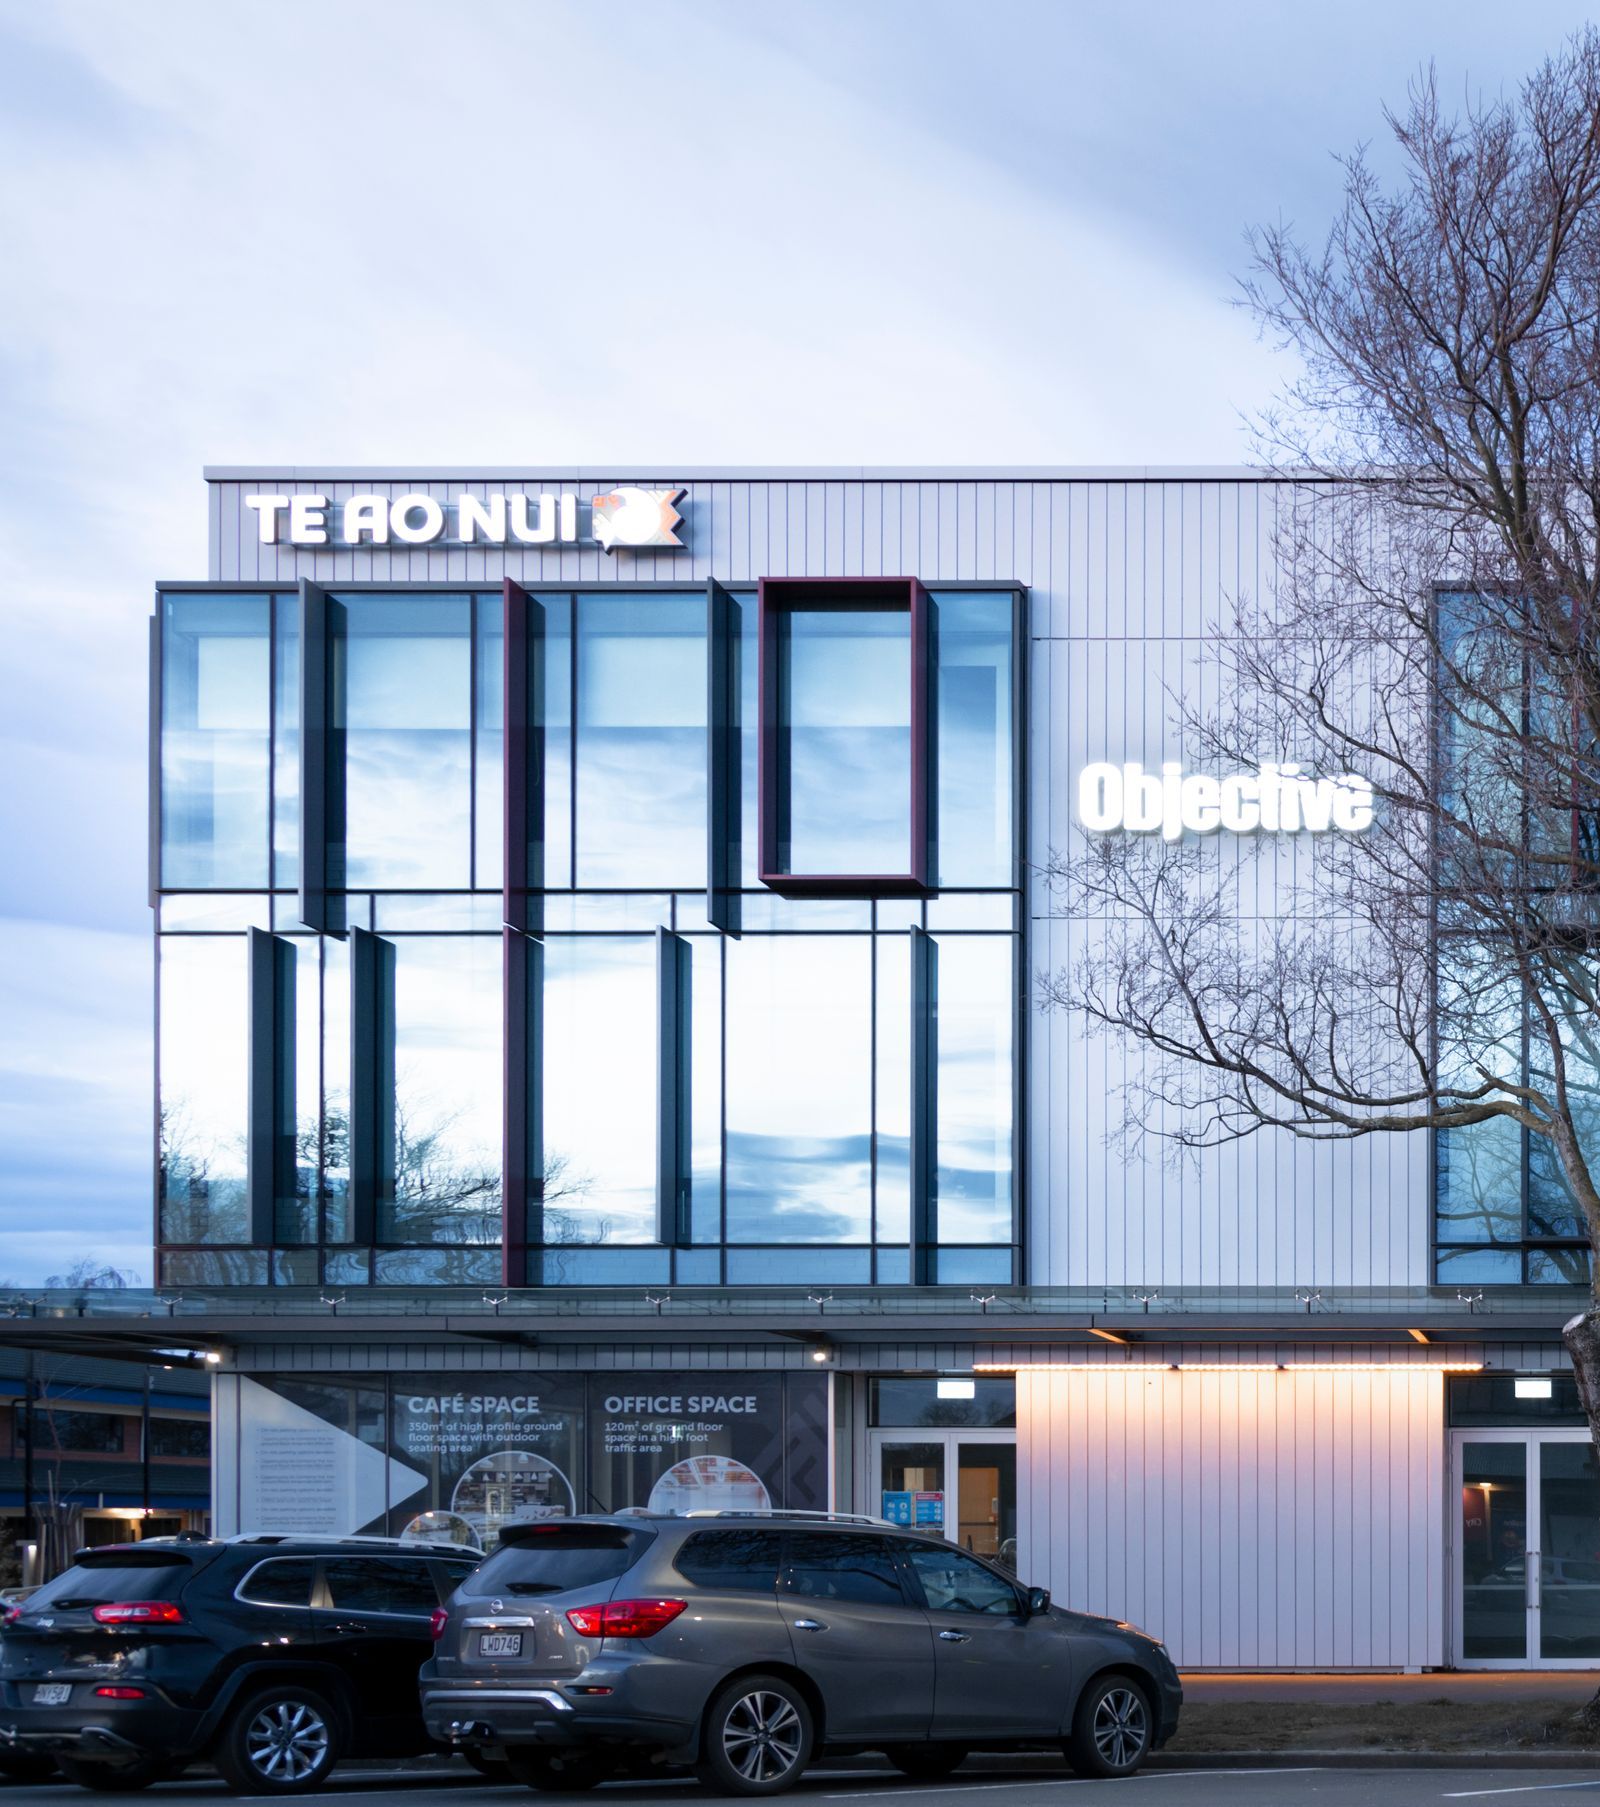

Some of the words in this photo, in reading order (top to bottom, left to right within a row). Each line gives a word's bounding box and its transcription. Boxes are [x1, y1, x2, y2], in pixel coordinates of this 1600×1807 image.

[245, 494, 330, 545] TE
[343, 494, 449, 545] AO
[457, 493, 579, 544] NUI
[1079, 763, 1373, 841] Objective
[408, 1392, 464, 1413] CAFÉ
[470, 1396, 540, 1413] SPACE
[604, 1396, 683, 1413] OFFICE
[687, 1396, 758, 1413] SPACE
[446, 1422, 457, 1431] of
[459, 1422, 483, 1434] high
[486, 1421, 520, 1434] profile
[523, 1422, 563, 1434] ground
[642, 1422, 653, 1431] of
[697, 1421, 723, 1431] floor
[408, 1432, 433, 1441] floor
[437, 1434, 467, 1445] space
[470, 1432, 493, 1441] with
[496, 1432, 540, 1441] outdoor
[604, 1434, 636, 1443] space
[638, 1432, 648, 1441] in
[659, 1432, 683, 1443] high
[686, 1432, 708, 1441] foot
[408, 1443, 446, 1454] seating
[450, 1444, 472, 1452] area
[604, 1443, 637, 1452] traffic
